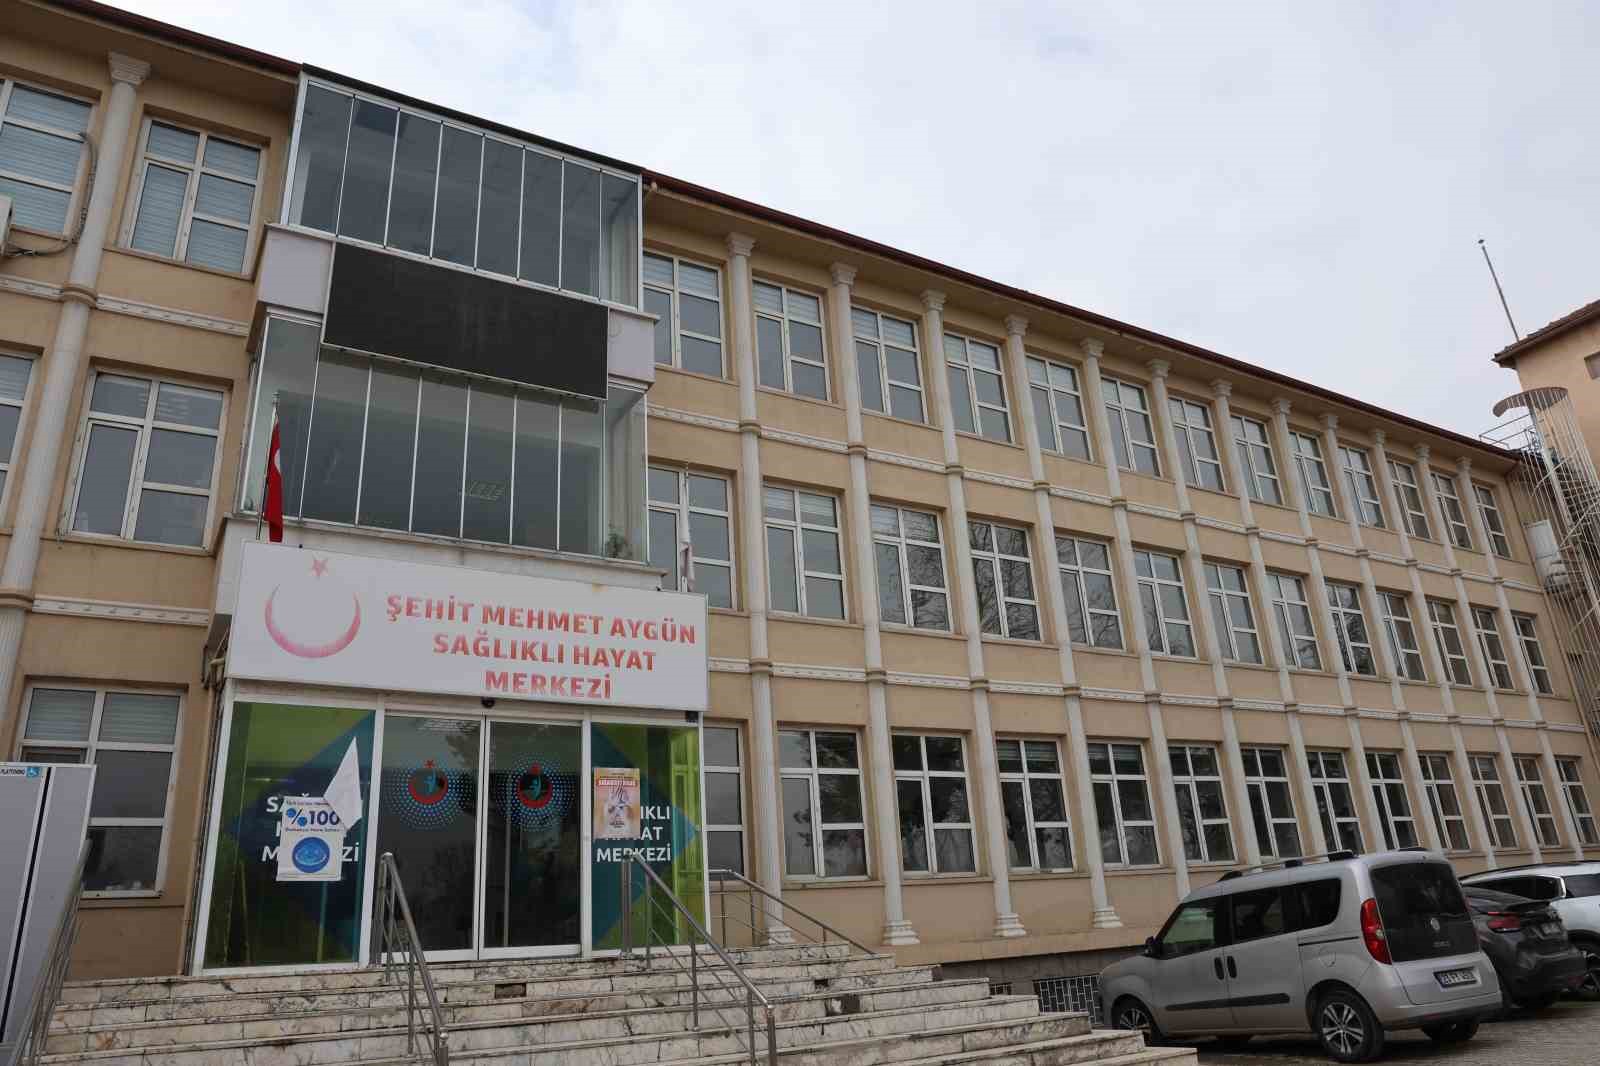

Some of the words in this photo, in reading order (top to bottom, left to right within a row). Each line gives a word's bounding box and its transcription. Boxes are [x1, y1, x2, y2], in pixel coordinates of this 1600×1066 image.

[386, 595, 474, 623] ŞEHİT
[481, 605, 603, 635] MEHMET
[609, 617, 695, 644] AYGÜN
[432, 629, 564, 664] SAĞLIKLI
[573, 644, 656, 671] HAYAT
[485, 670, 611, 699] MERKEZİ
